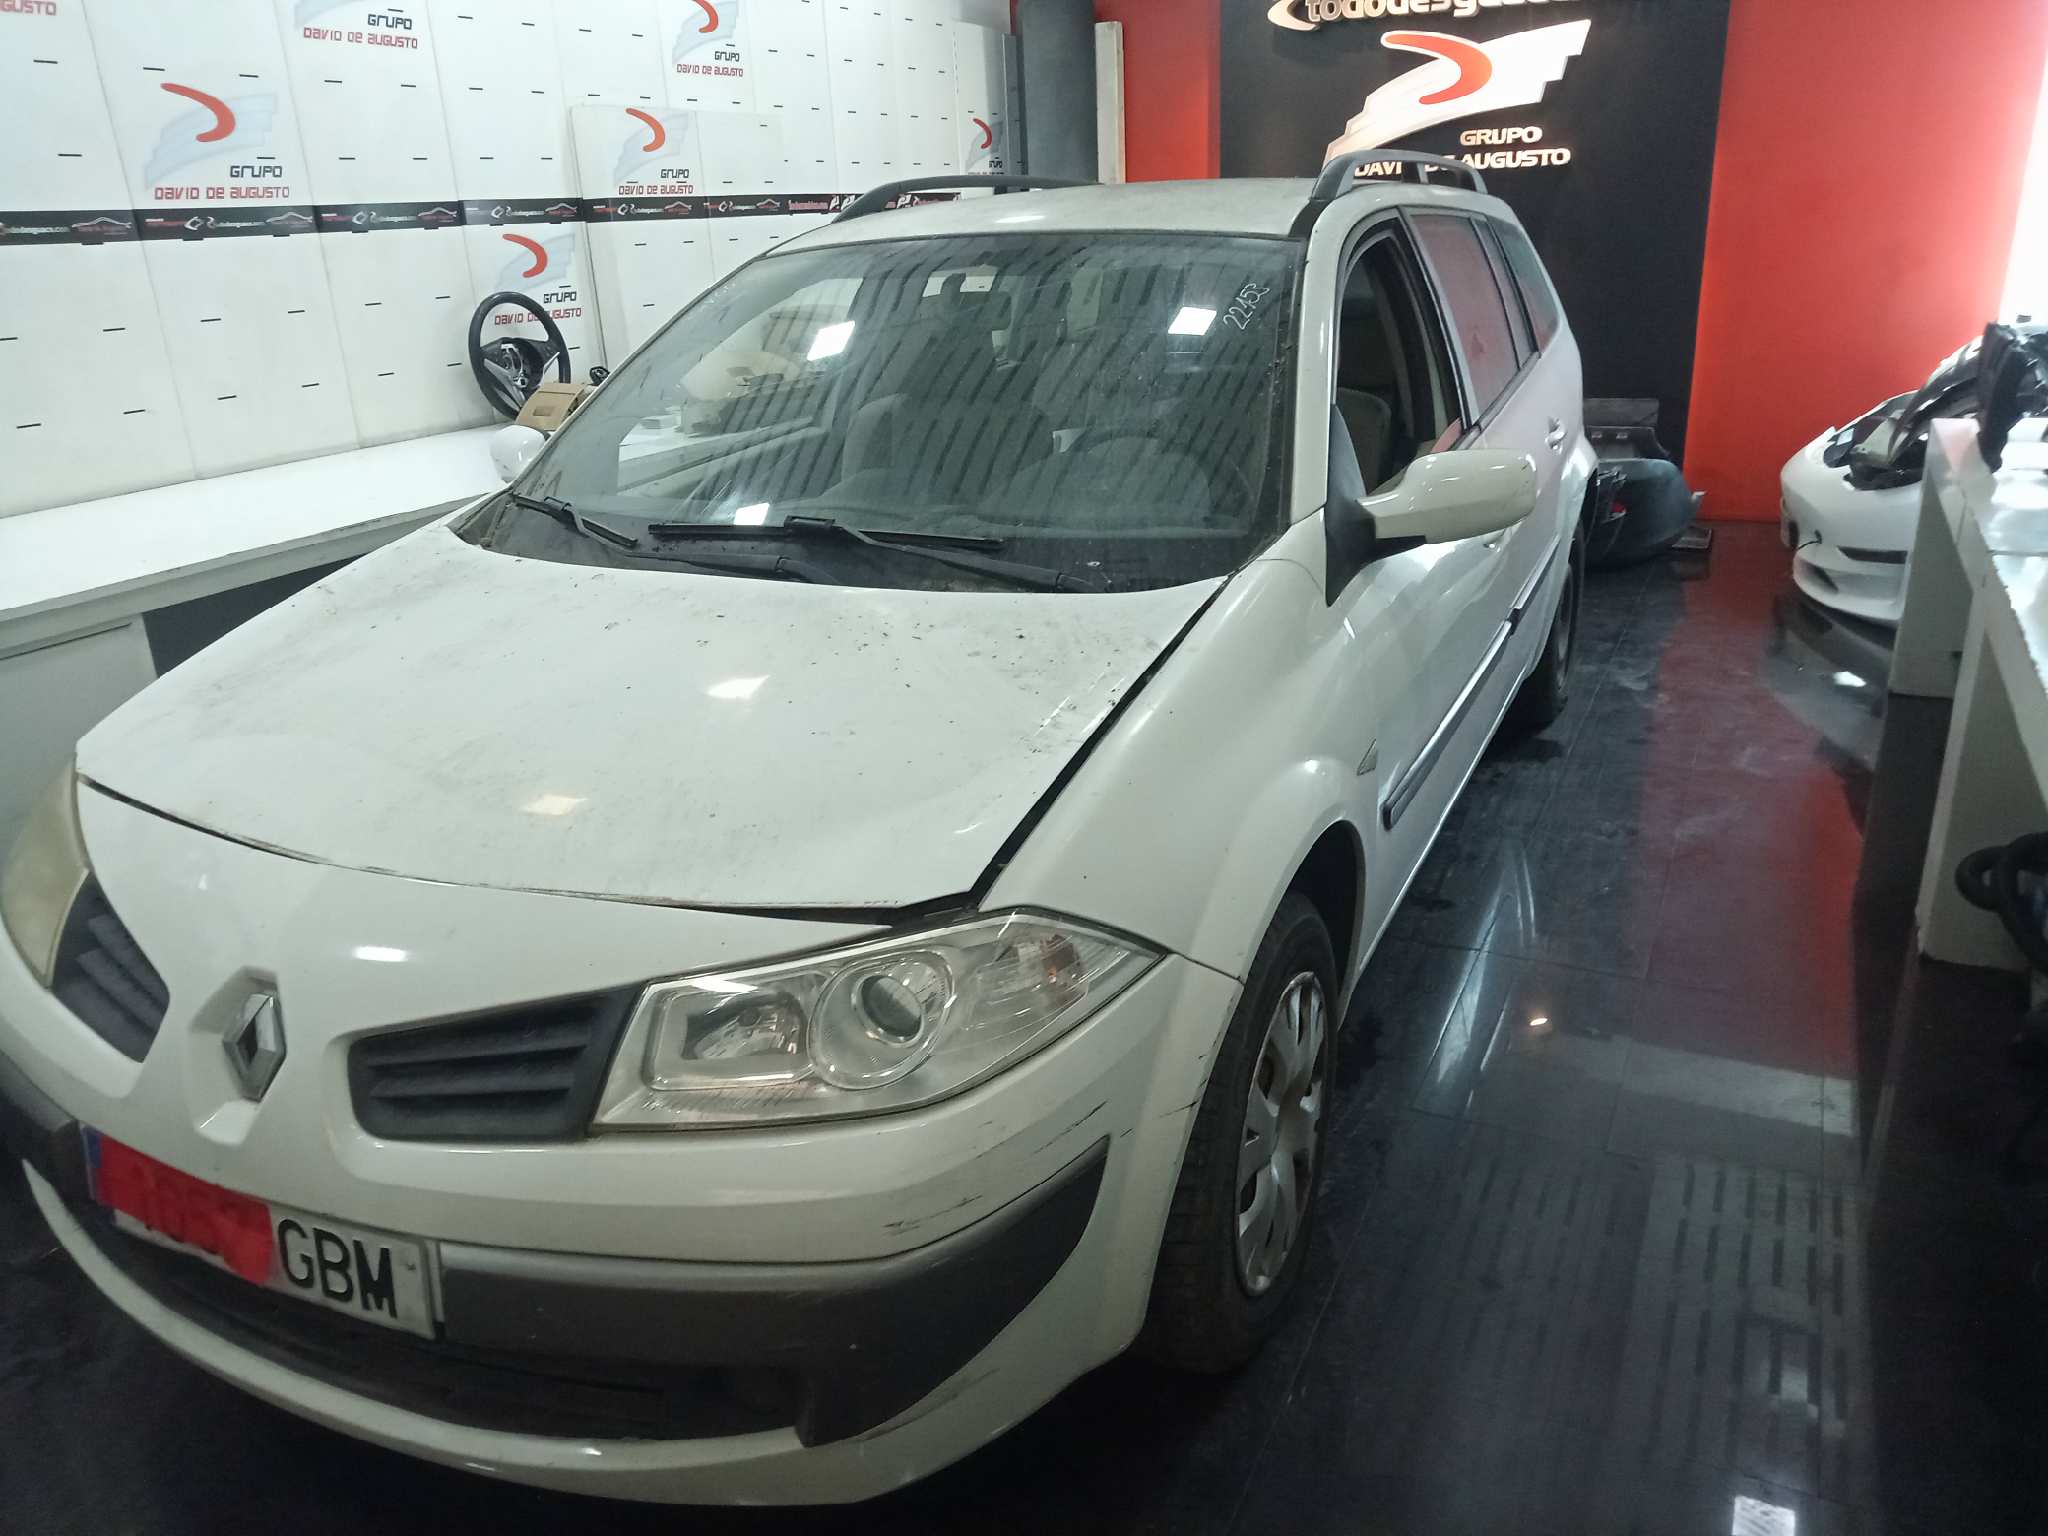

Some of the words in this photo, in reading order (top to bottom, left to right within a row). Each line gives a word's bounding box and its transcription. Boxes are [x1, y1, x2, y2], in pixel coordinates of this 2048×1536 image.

[1459, 126, 1543, 146] GRUPO
[1354, 161, 1402, 177] DAVI
[1460, 148, 1571, 170] AUGUSTO
[277, 1218, 398, 1319] GBM
